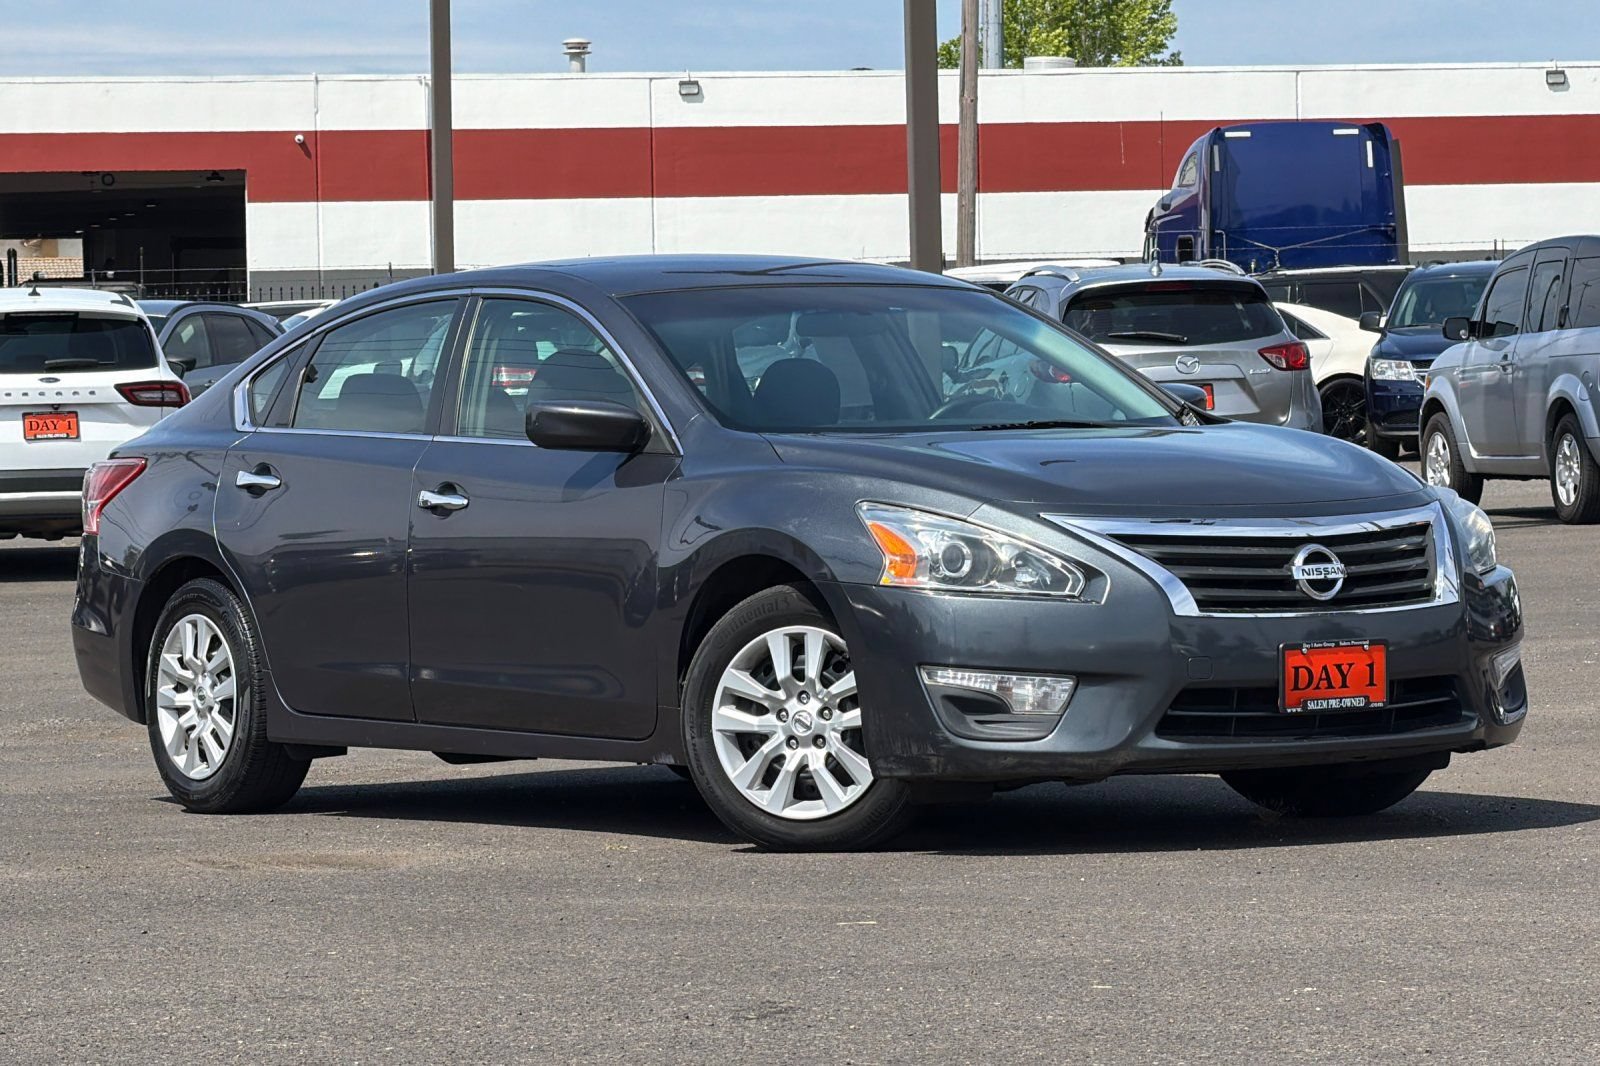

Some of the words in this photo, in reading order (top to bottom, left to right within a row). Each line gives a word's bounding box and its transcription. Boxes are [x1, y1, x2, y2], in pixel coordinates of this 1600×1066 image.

[29, 420, 59, 431] DAY
[66, 420, 73, 431] 1
[1301, 566, 1345, 577] NISSAN
[1290, 662, 1355, 691] DAY
[1365, 661, 1378, 687] 1
[1307, 700, 1328, 710] SALEM
[1328, 697, 1366, 709] PRE-OWNED
